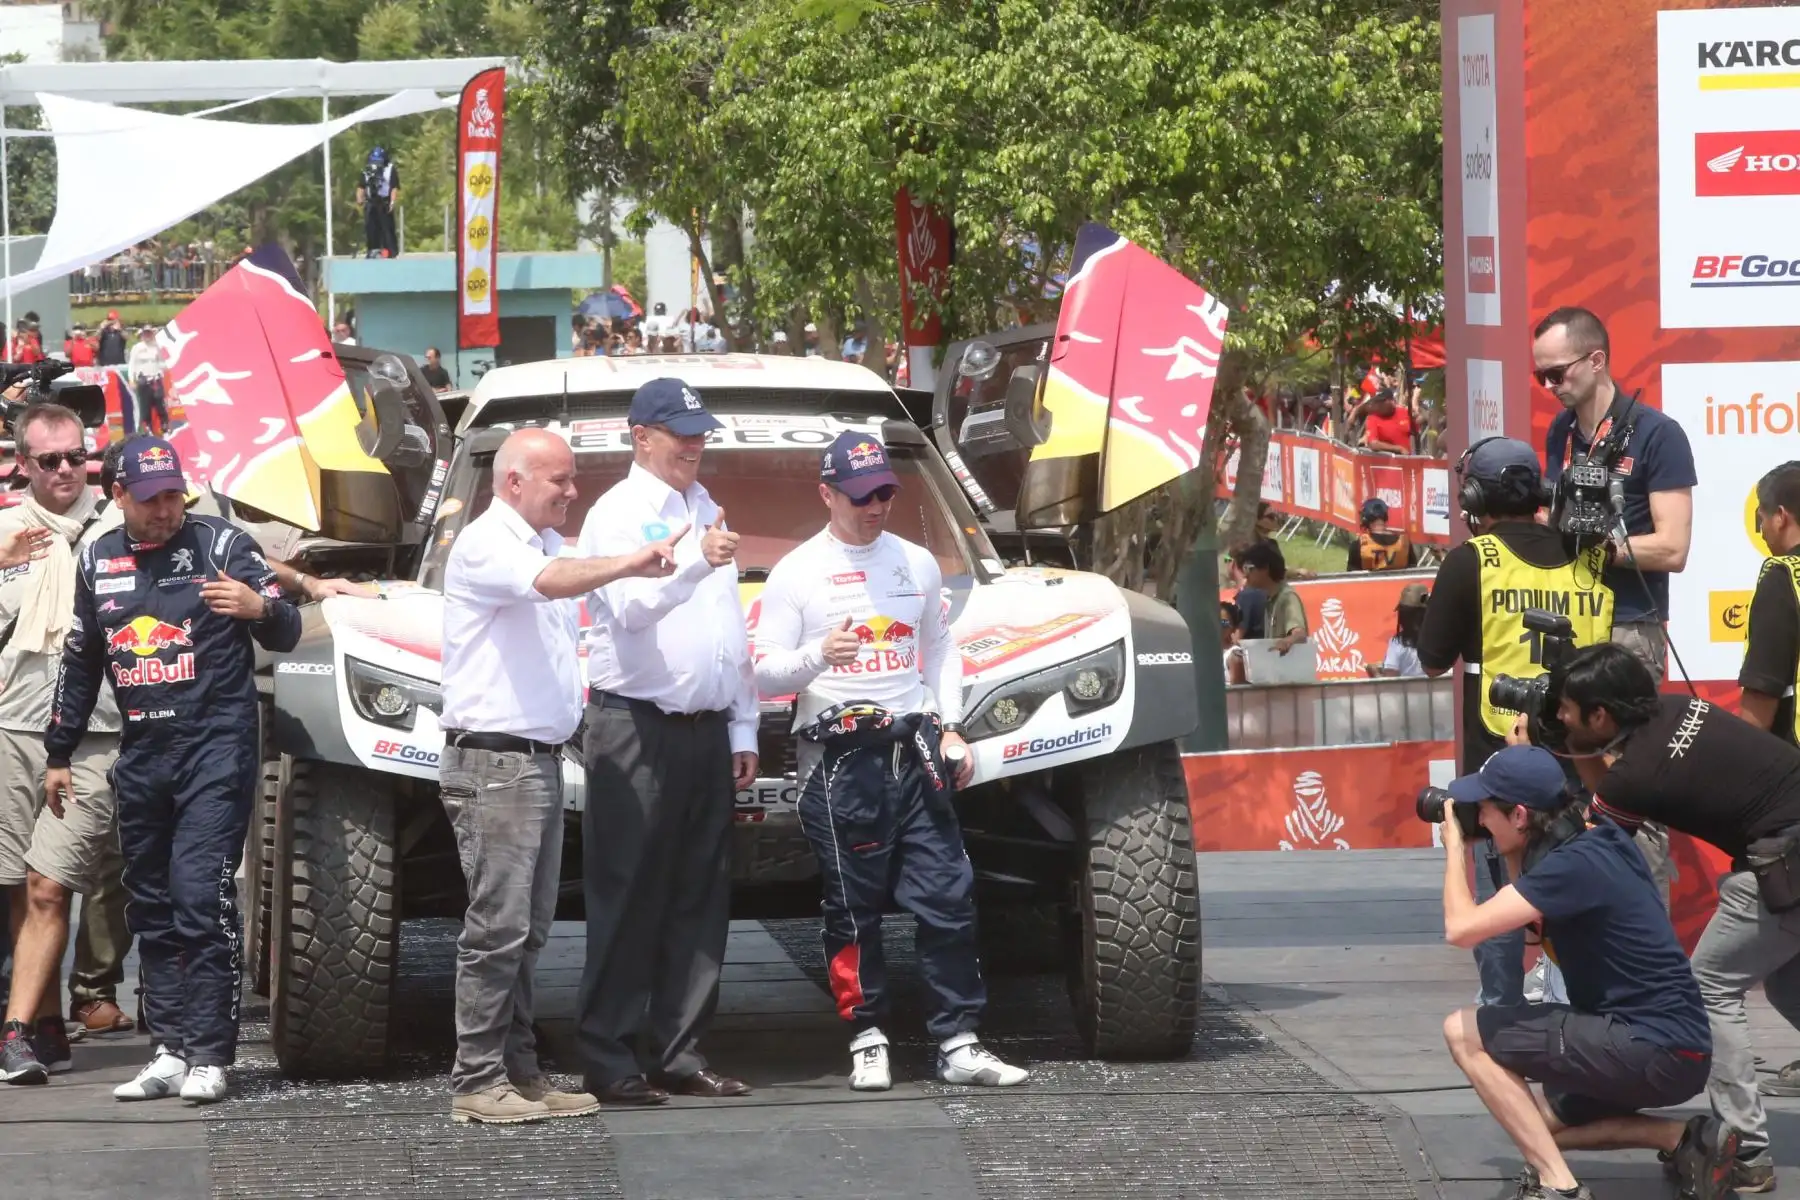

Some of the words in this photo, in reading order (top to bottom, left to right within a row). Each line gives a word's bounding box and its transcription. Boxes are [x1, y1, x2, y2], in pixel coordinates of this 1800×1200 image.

[1463, 54, 1490, 86] TOYOTA
[1466, 144, 1492, 180] sodexo
[1745, 154, 1800, 172] HO
[1705, 392, 1800, 435] info
[1492, 589, 1570, 616] PODIUM
[1575, 592, 1604, 617] TV
[960, 637, 1001, 654] 306
[1137, 652, 1192, 665] sparco
[112, 657, 146, 688] Red
[146, 652, 195, 685] Bull
[277, 662, 335, 675] sparco
[149, 709, 176, 719] ELENA
[1003, 723, 1112, 759] BFGoodrich
